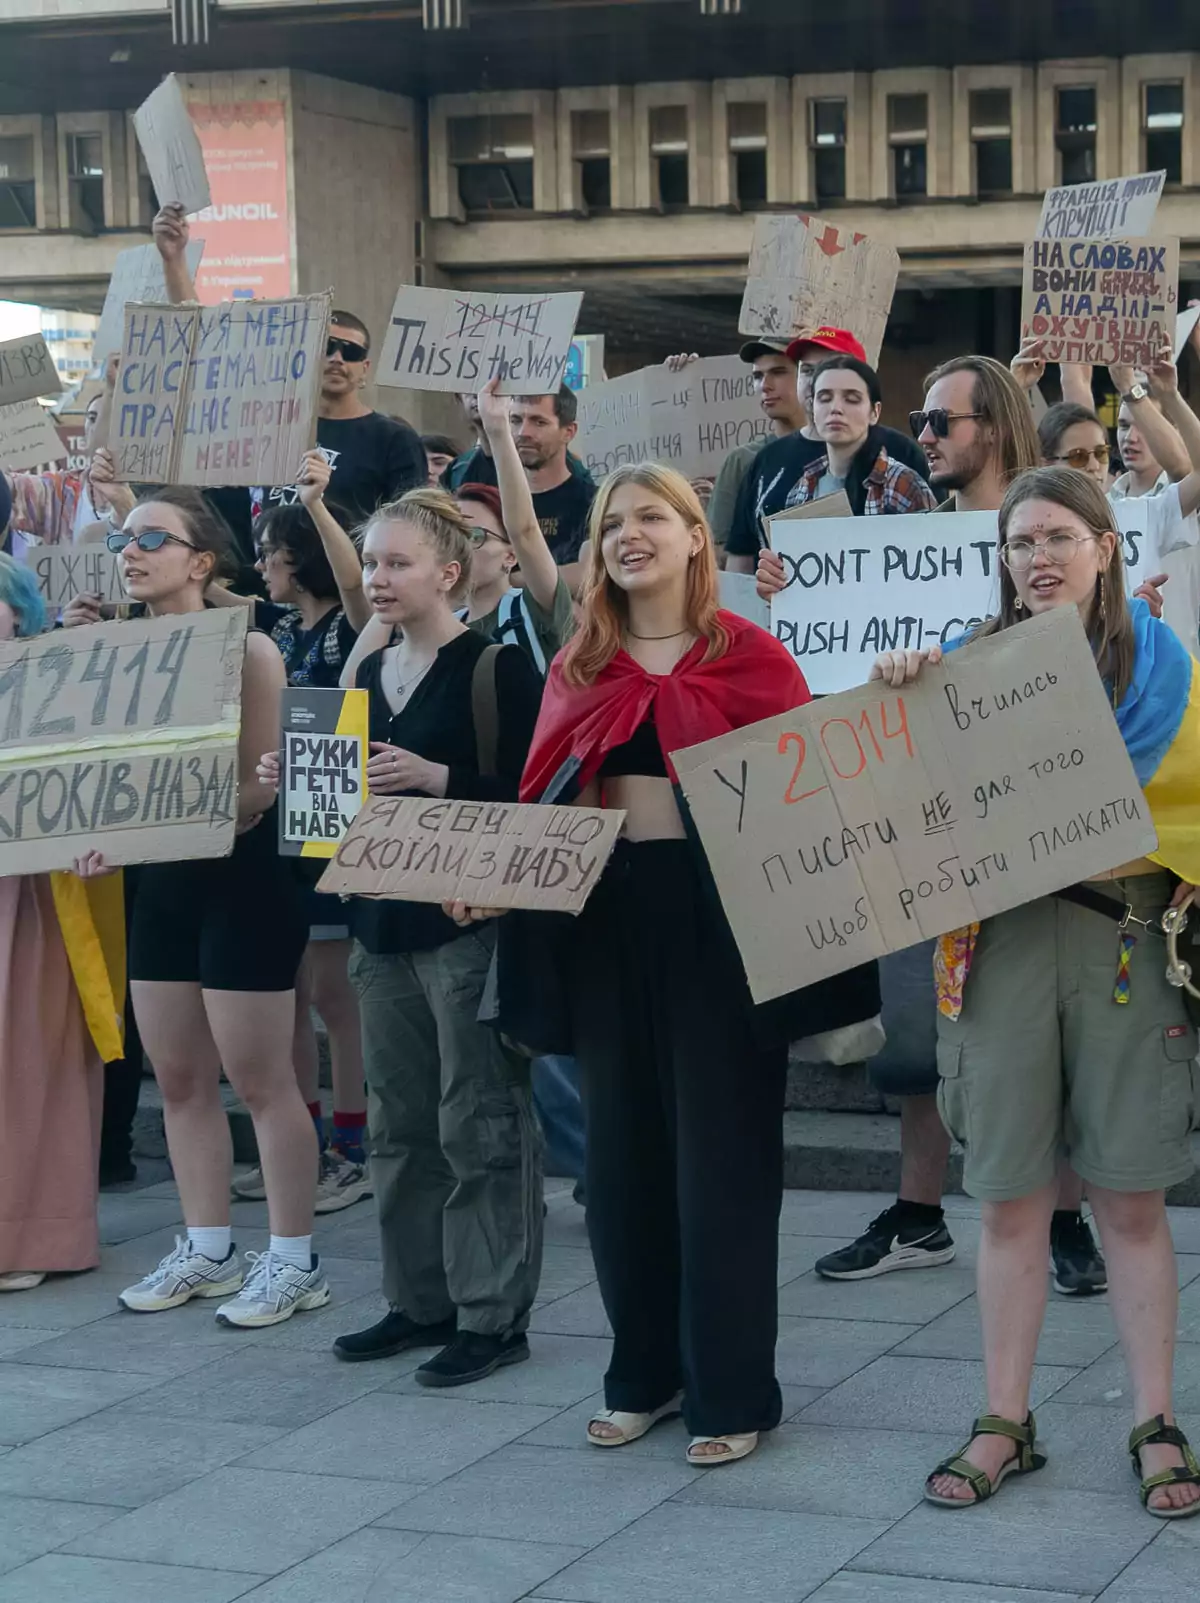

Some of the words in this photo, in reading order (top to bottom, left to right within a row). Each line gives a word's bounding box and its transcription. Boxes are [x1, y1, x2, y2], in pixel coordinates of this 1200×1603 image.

[1033, 241, 1064, 268] НА
[1069, 243, 1166, 272] СЛОВАХ
[1032, 270, 1096, 293] ВОНИ
[456, 303, 542, 338] 12414
[1034, 294, 1051, 314] А
[1061, 294, 1092, 316] НА
[127, 313, 231, 357] НАХУЯ
[245, 306, 309, 348] МЕНІ
[1032, 315, 1162, 340] ОХУЇВША
[393, 317, 452, 376] This
[457, 346, 480, 379] is
[487, 344, 523, 380] the
[269, 350, 307, 386] ЩО
[673, 386, 693, 409] ЦЕ
[119, 396, 231, 438] ПРАЦЮЄ
[240, 399, 301, 428] ПРОТИ
[778, 548, 871, 590] DONT
[884, 545, 963, 583] PUSH
[776, 619, 849, 657] PUSH
[0, 625, 195, 741] 12414
[290, 738, 358, 768] РУКИ
[713, 760, 748, 833] У
[776, 696, 915, 805] 2014
[944, 670, 1058, 731] вчилась
[141, 754, 235, 829] НАЗАД
[290, 766, 358, 794] ГЕТЬ
[922, 791, 952, 828] НЕ
[974, 775, 1016, 819] для
[1028, 748, 1084, 782] того
[312, 793, 338, 812] ВІД
[289, 811, 357, 838] НАБУ
[360, 799, 403, 828] Я
[545, 809, 604, 845] ЩО
[337, 835, 462, 878] СКОЇЛИ
[467, 851, 497, 880] З
[502, 845, 597, 892] НАБУ
[898, 853, 1009, 920] робити
